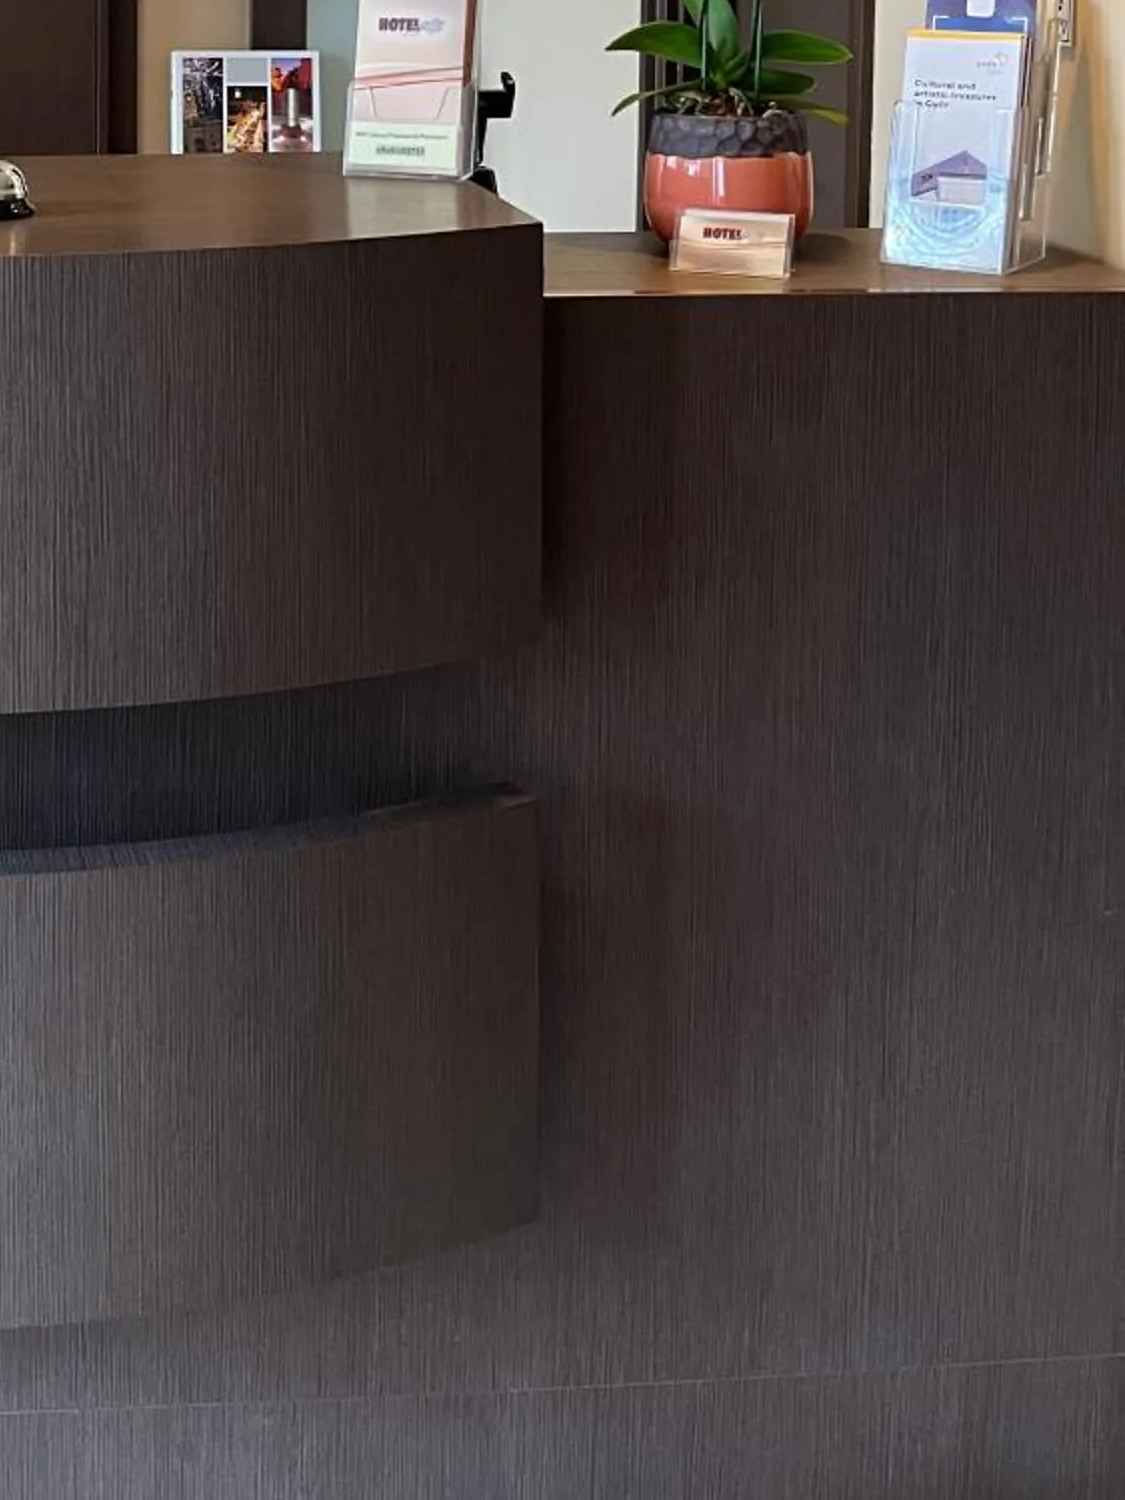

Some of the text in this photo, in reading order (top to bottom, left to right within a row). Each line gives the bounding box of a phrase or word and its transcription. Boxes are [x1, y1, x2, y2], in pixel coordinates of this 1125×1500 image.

[378, 17, 420, 32] HOTEL
[957, 82, 976, 90] and
[703, 227, 742, 241] HOTEL
